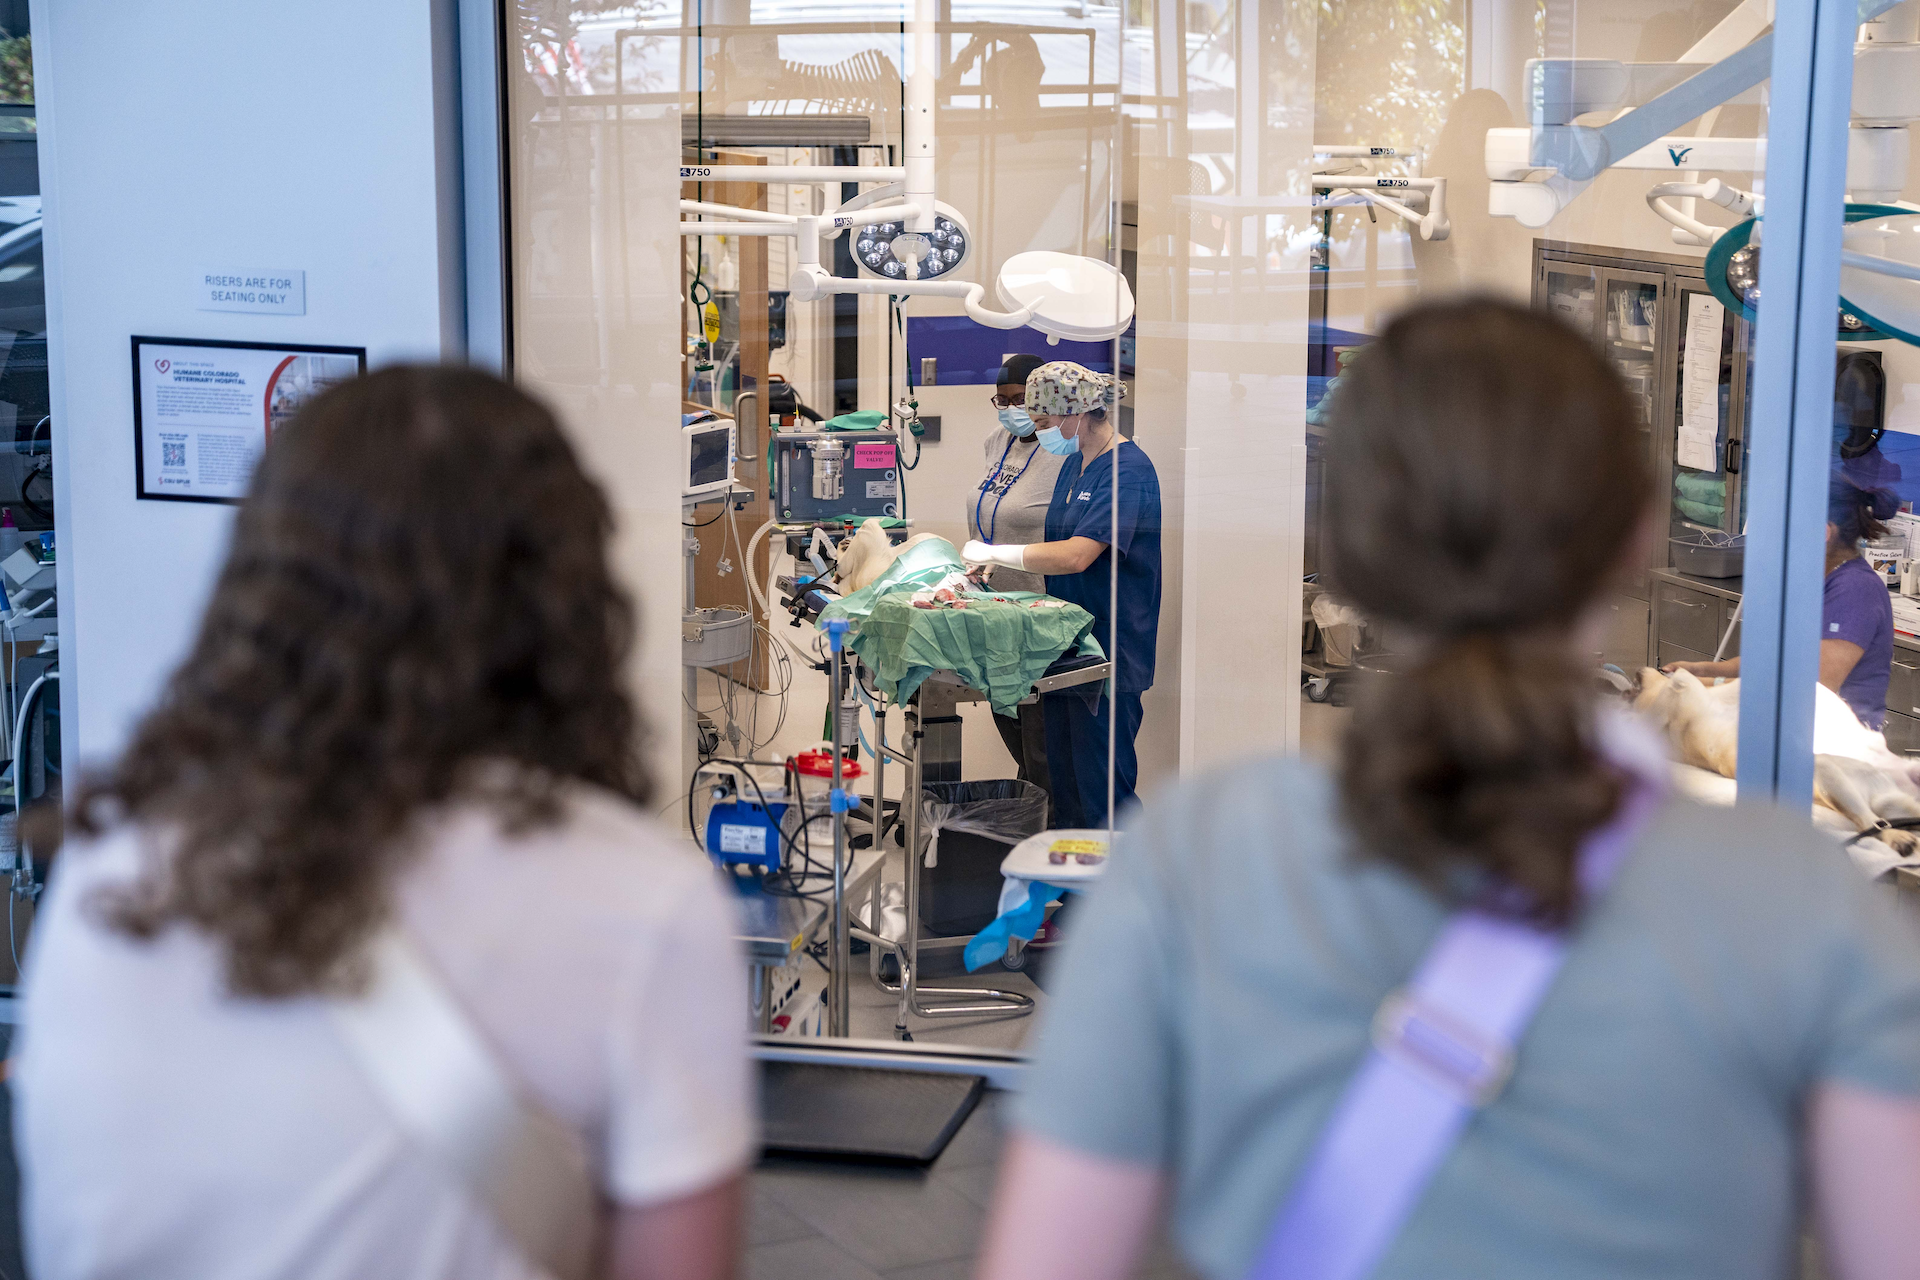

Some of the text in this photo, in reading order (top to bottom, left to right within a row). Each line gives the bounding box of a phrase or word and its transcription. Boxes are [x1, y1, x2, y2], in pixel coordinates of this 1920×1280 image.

[205, 275, 292, 290] RISERS ARE FOR
[211, 290, 287, 304] SEATING ONLY
[203, 370, 239, 378] COLORADO
[994, 461, 1024, 474] CORADO
